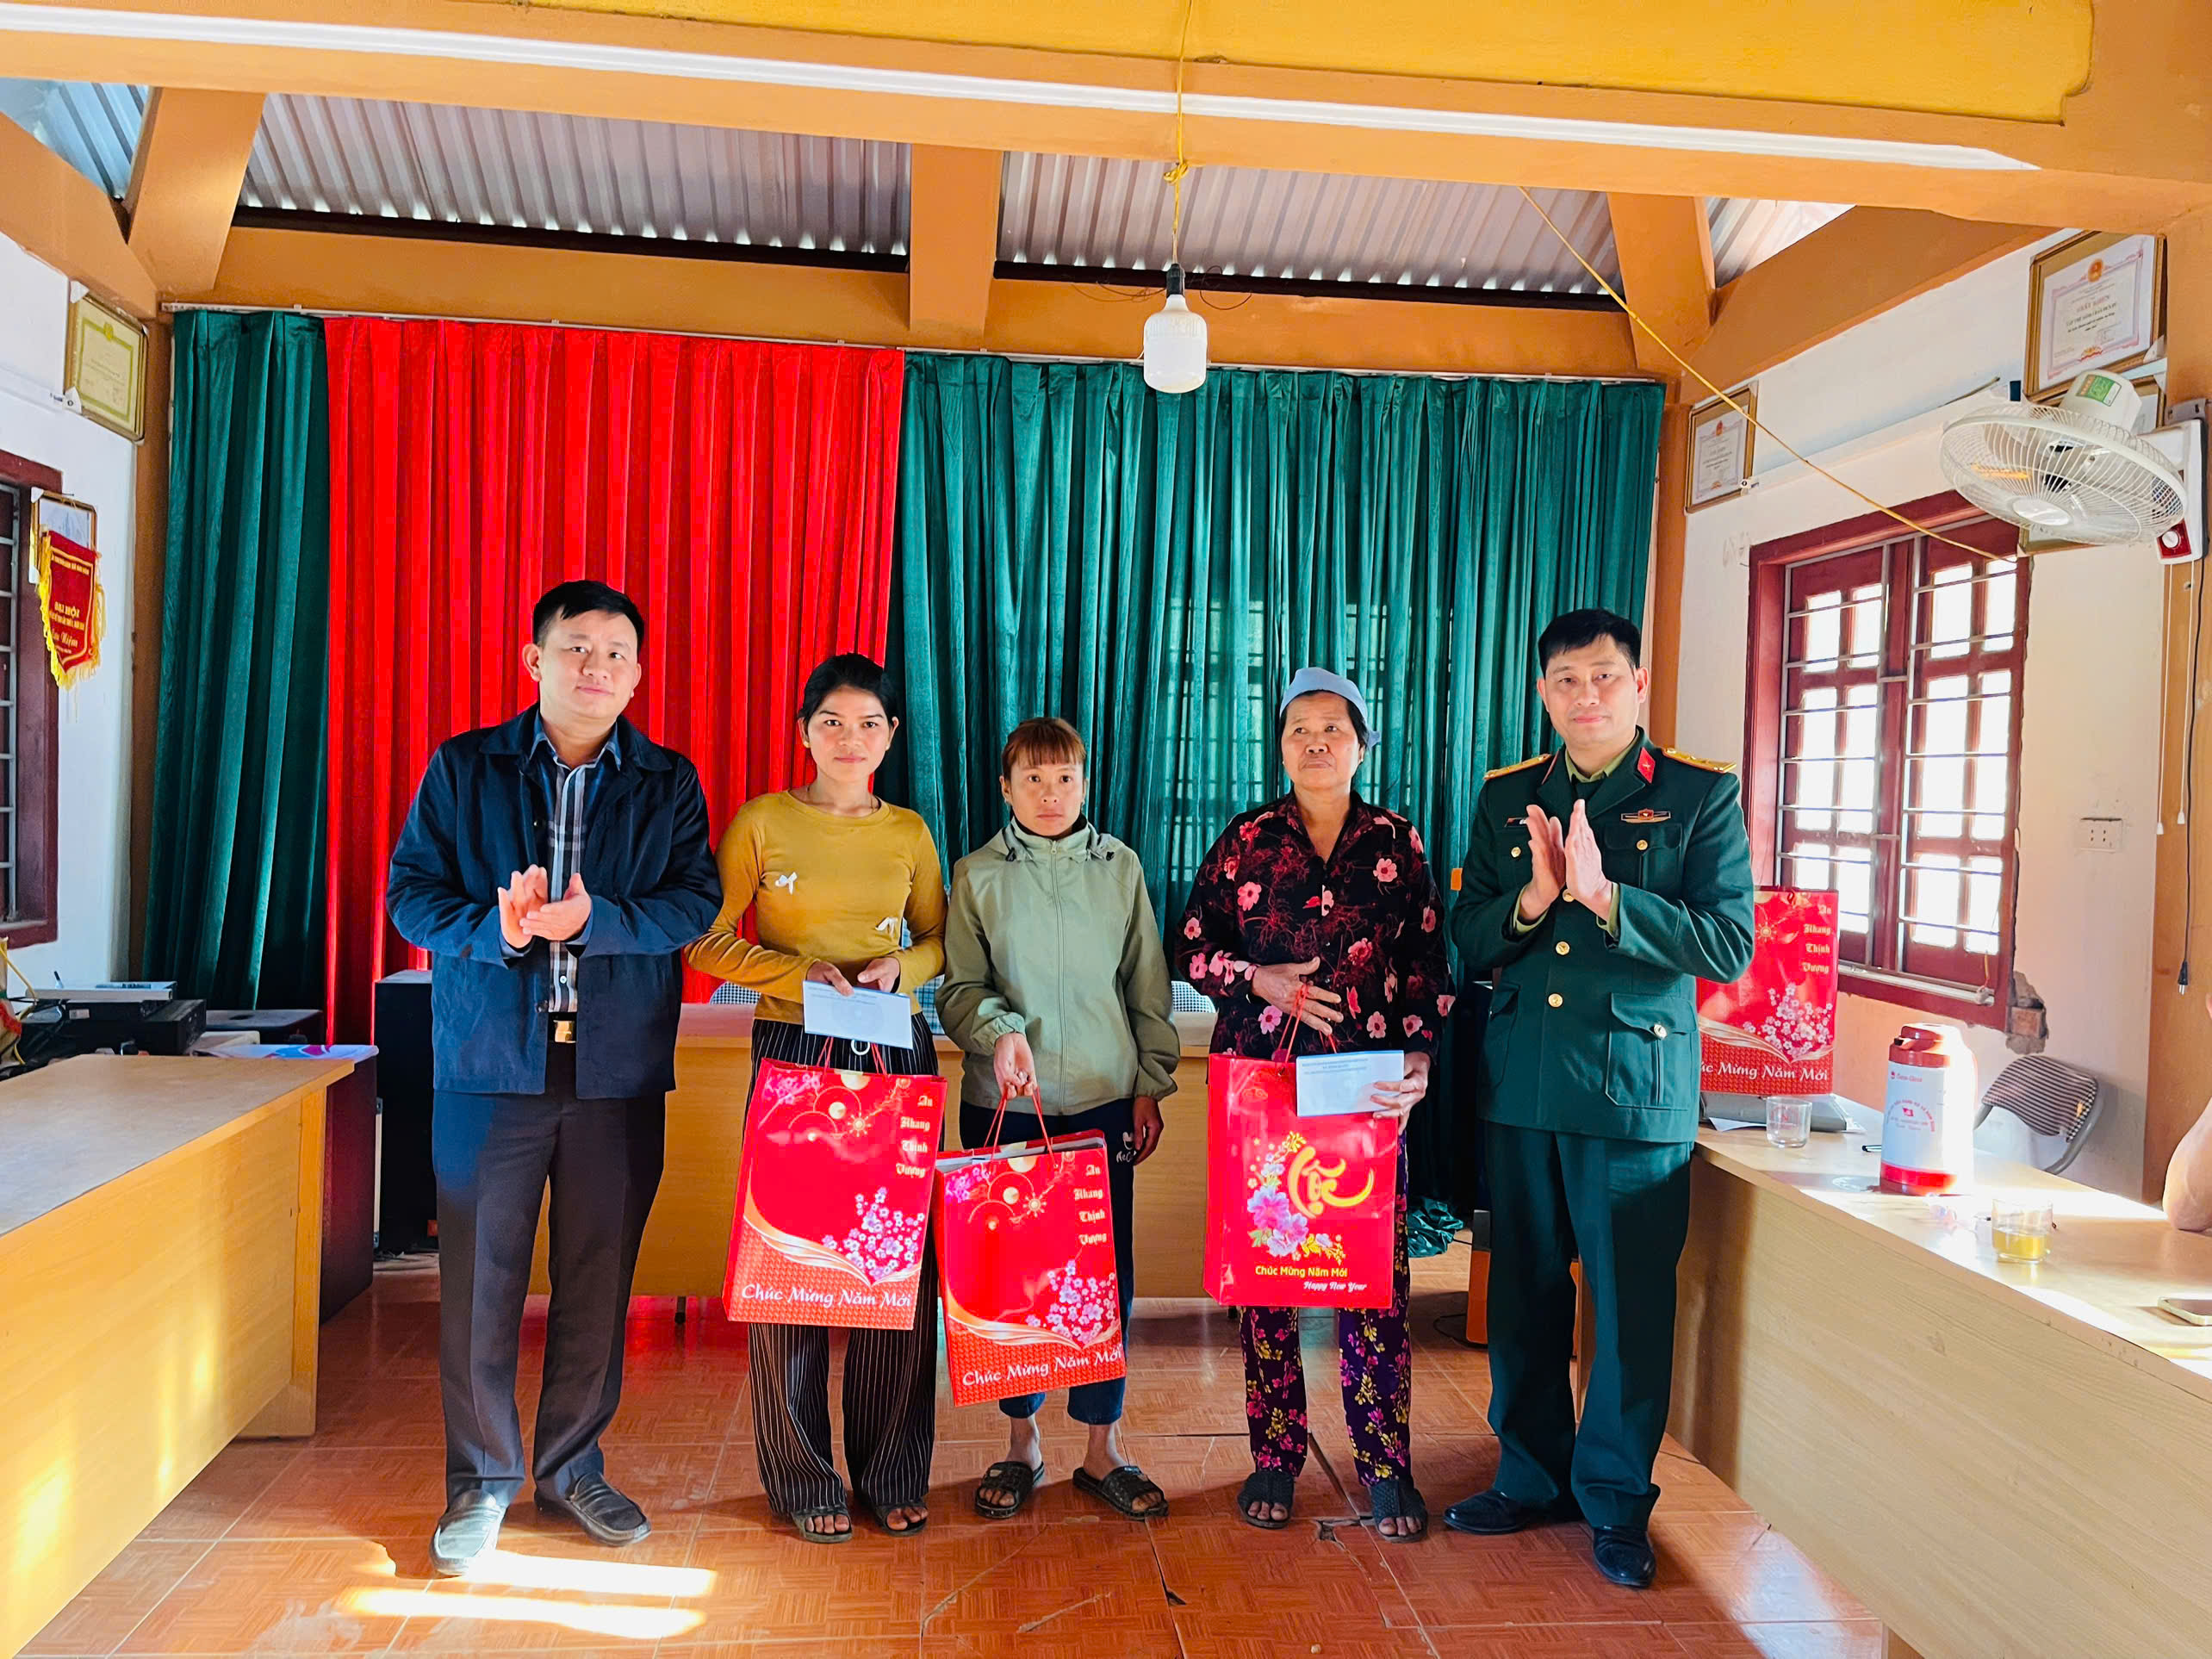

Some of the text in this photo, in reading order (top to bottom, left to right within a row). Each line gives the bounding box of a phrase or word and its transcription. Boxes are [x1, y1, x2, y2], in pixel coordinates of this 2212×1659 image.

[1718, 1062, 1758, 1080] Mừng
[1762, 1064, 1796, 1079] Năm
[1799, 1067, 1828, 1081] Mới
[1255, 1265, 1348, 1278] Chúc Mừng Năm Mới
[742, 1283, 912, 1308] Chúc Mừng Năm Mới
[1303, 1281, 1368, 1293] Happy New Year
[962, 1343, 1123, 1386] Chúc Mừng Năm Mới
